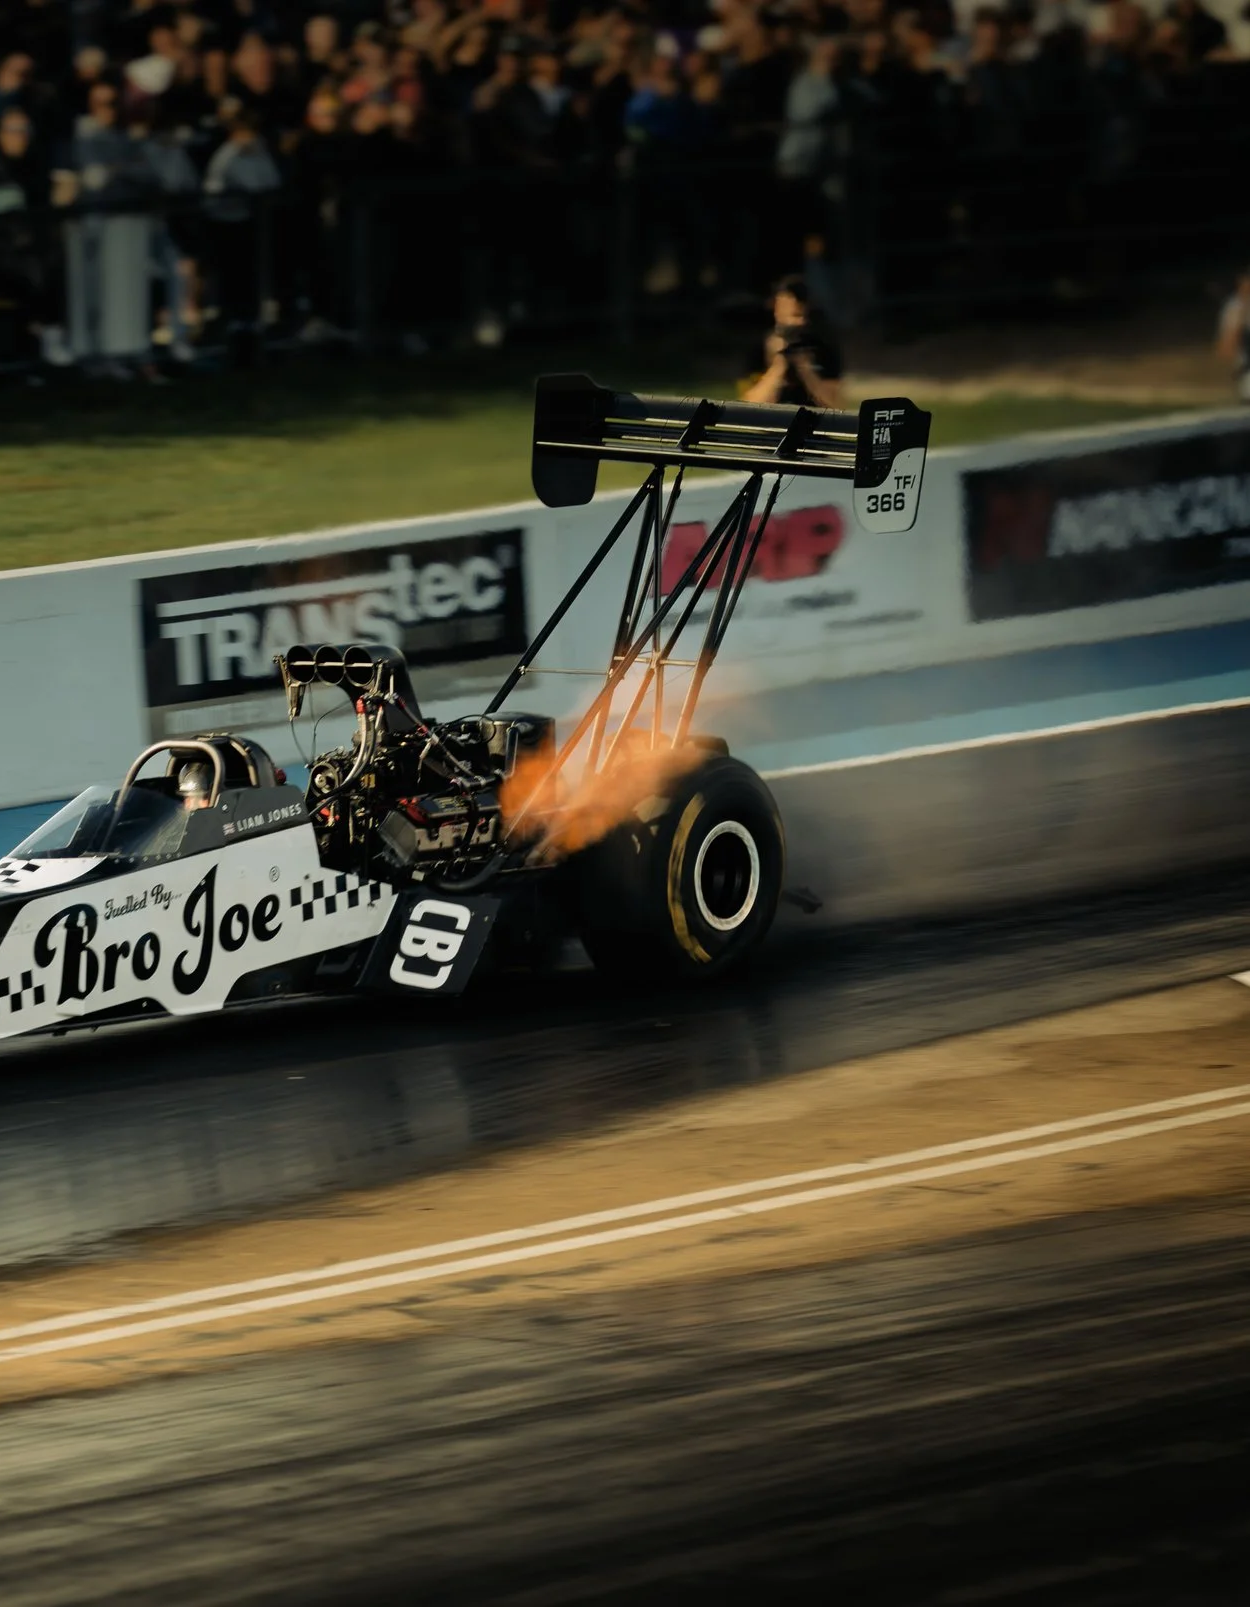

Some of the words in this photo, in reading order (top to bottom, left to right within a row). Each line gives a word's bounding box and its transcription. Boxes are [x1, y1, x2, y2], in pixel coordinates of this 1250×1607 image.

[866, 492, 905, 513] 366
[236, 812, 265, 832] LIAM
[266, 803, 302, 824] JONES
[34, 903, 162, 1006] Bro
[172, 862, 284, 997] Joe
